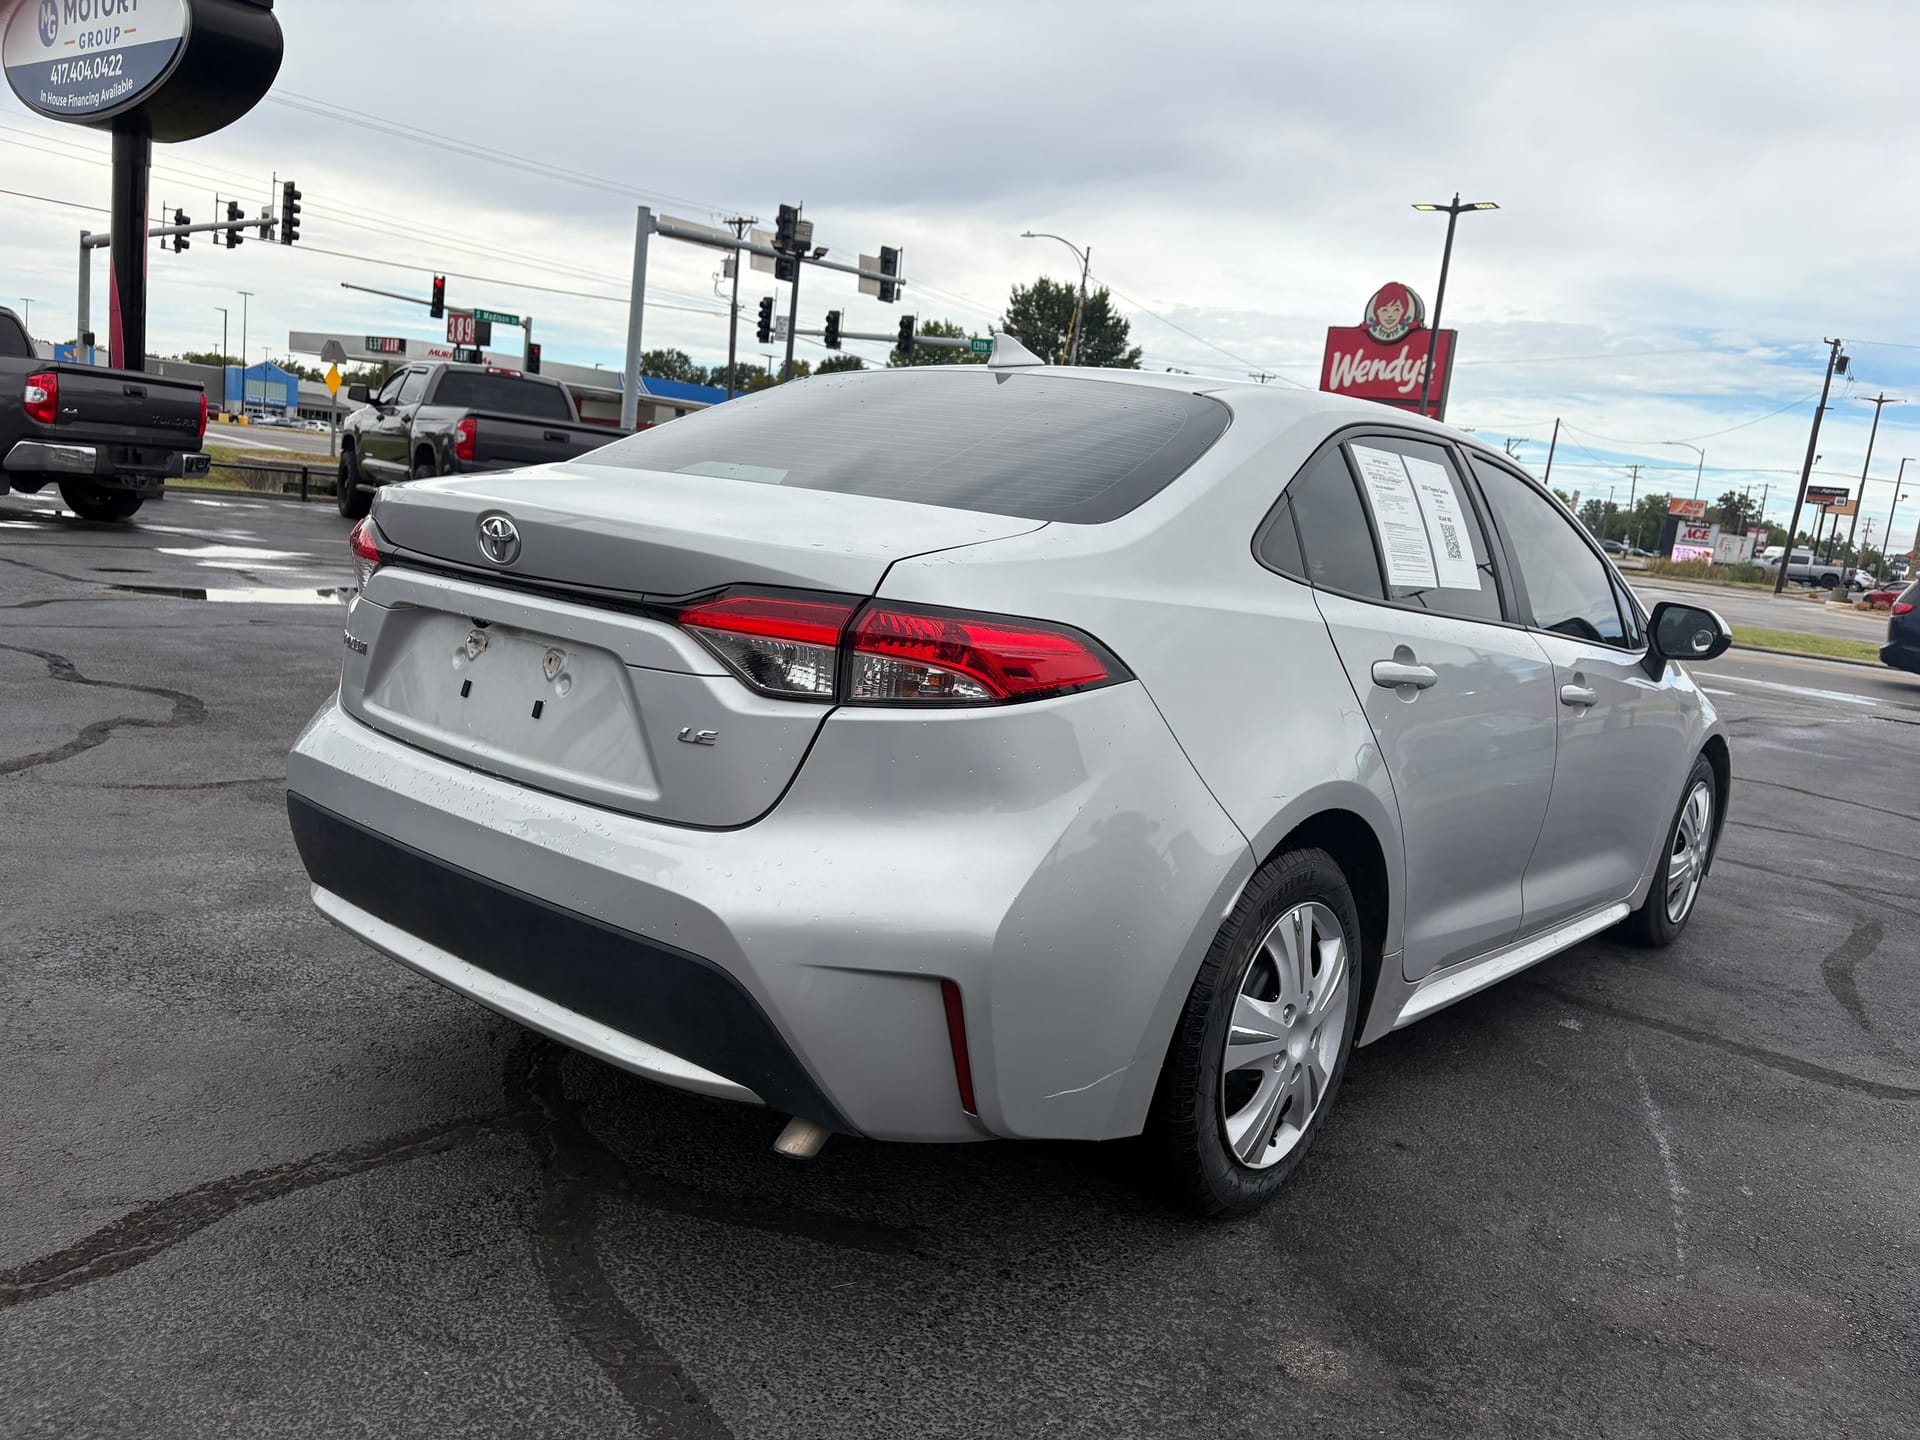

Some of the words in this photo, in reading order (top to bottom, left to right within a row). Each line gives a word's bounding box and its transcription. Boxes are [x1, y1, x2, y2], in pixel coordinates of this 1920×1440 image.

[79, 26, 121, 49] GROUP
[50, 54, 123, 85] 417.404.0422
[40, 89, 47, 103] In
[47, 92, 67, 107] House
[68, 92, 100, 107] Financing
[100, 78, 134, 103] Available
[483, 312, 510, 322] Madison
[448, 317, 472, 342] 3.89
[1682, 528, 1711, 540] ACE
[677, 727, 719, 747] LE
